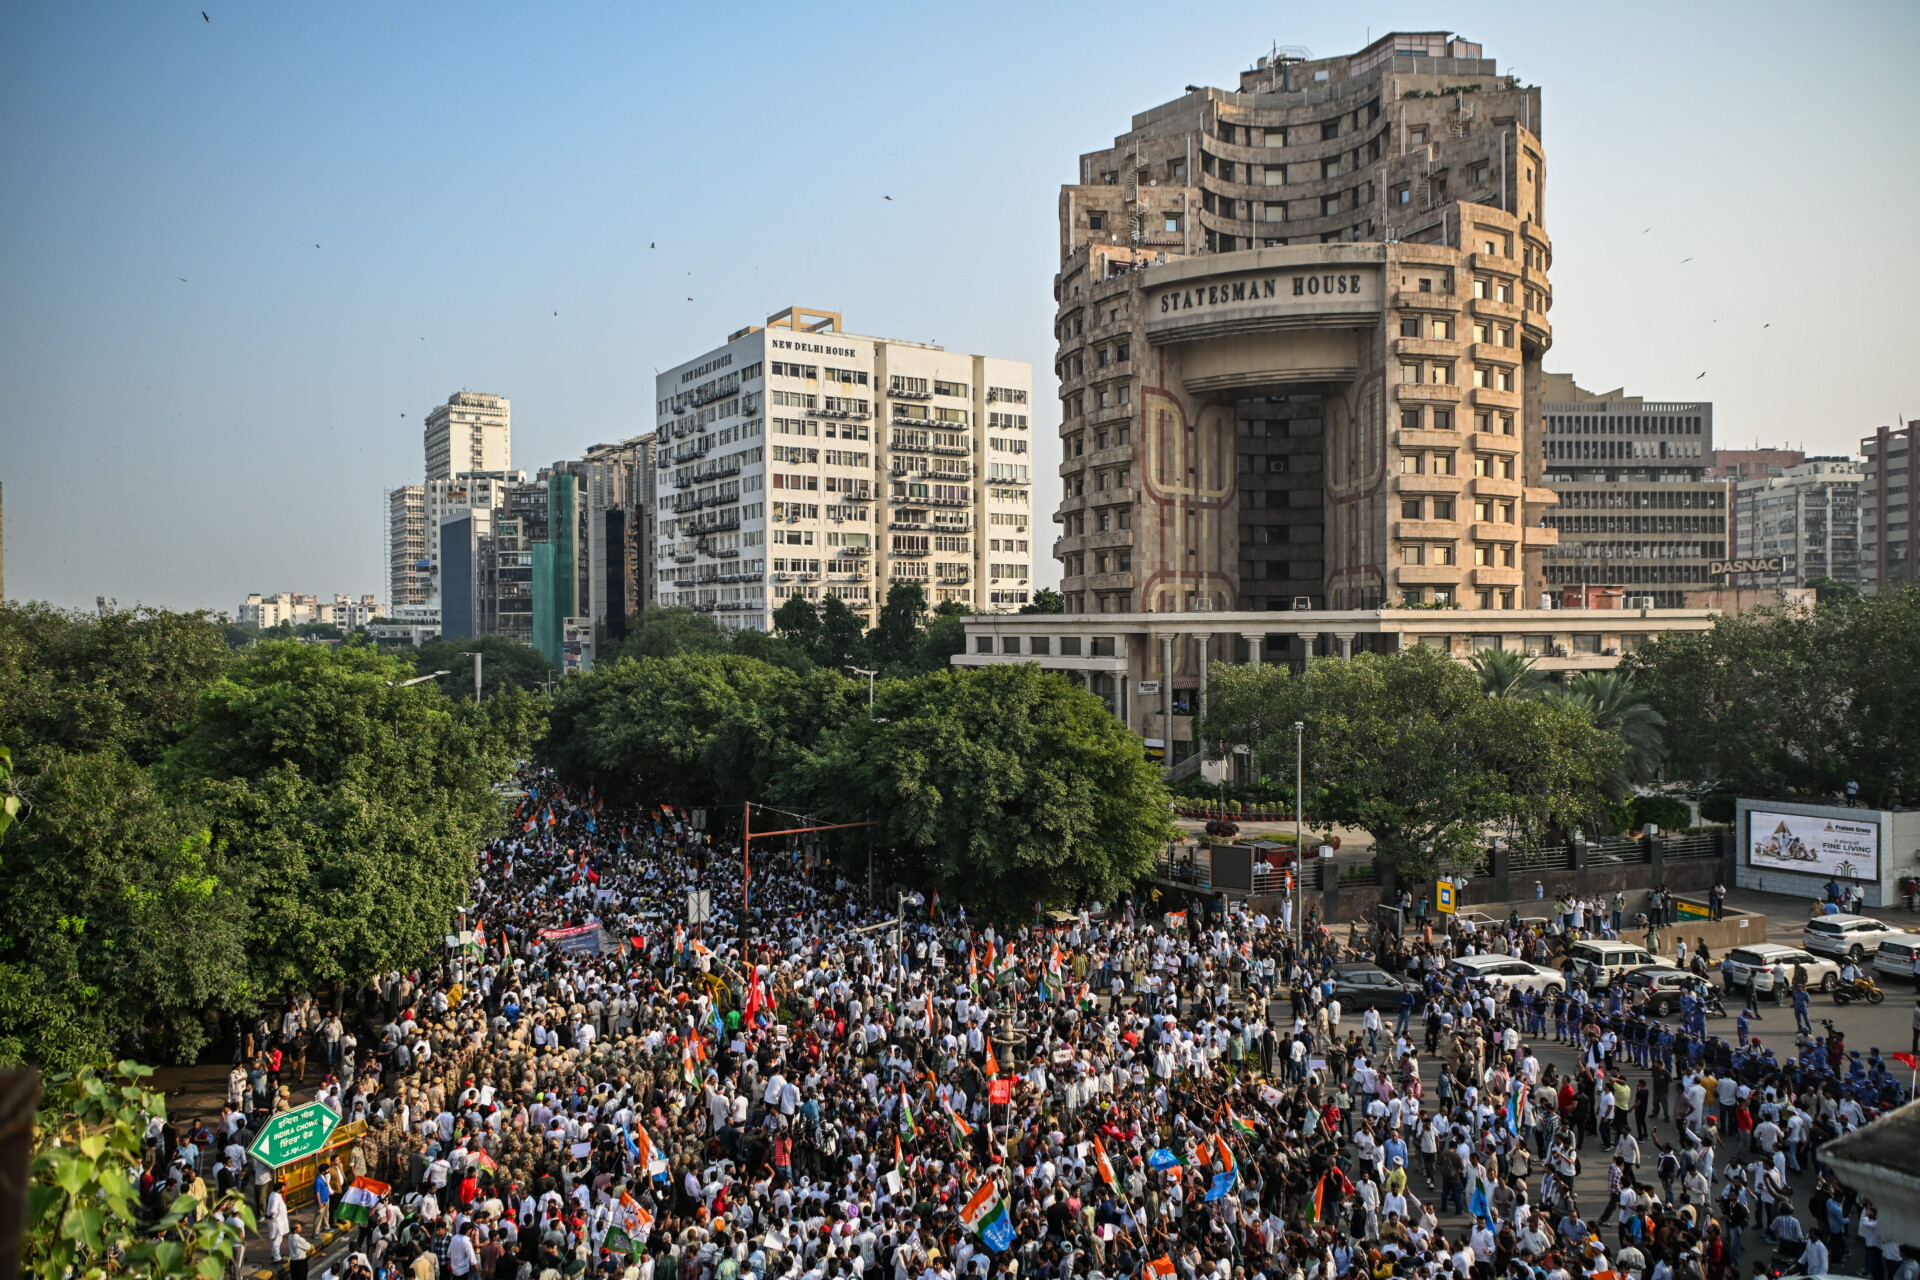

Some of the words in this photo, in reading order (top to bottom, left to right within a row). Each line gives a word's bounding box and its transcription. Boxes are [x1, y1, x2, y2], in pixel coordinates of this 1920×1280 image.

[1161, 279, 1275, 313] STATESMAN
[1292, 275, 1361, 296] HOUSE
[772, 339, 792, 350] NEW
[795, 342, 824, 354] DELHI
[826, 346, 856, 358] HOUSE
[681, 369, 694, 384] NEW
[694, 361, 712, 379] DELHI
[713, 353, 732, 371] HOUSE
[1711, 558, 1779, 575] DASNAC
[1822, 842, 1841, 850] FINE
[1843, 845, 1871, 853] LIVING
[273, 1128, 295, 1140] INDIRA
[296, 1119, 319, 1132] CHOWK
